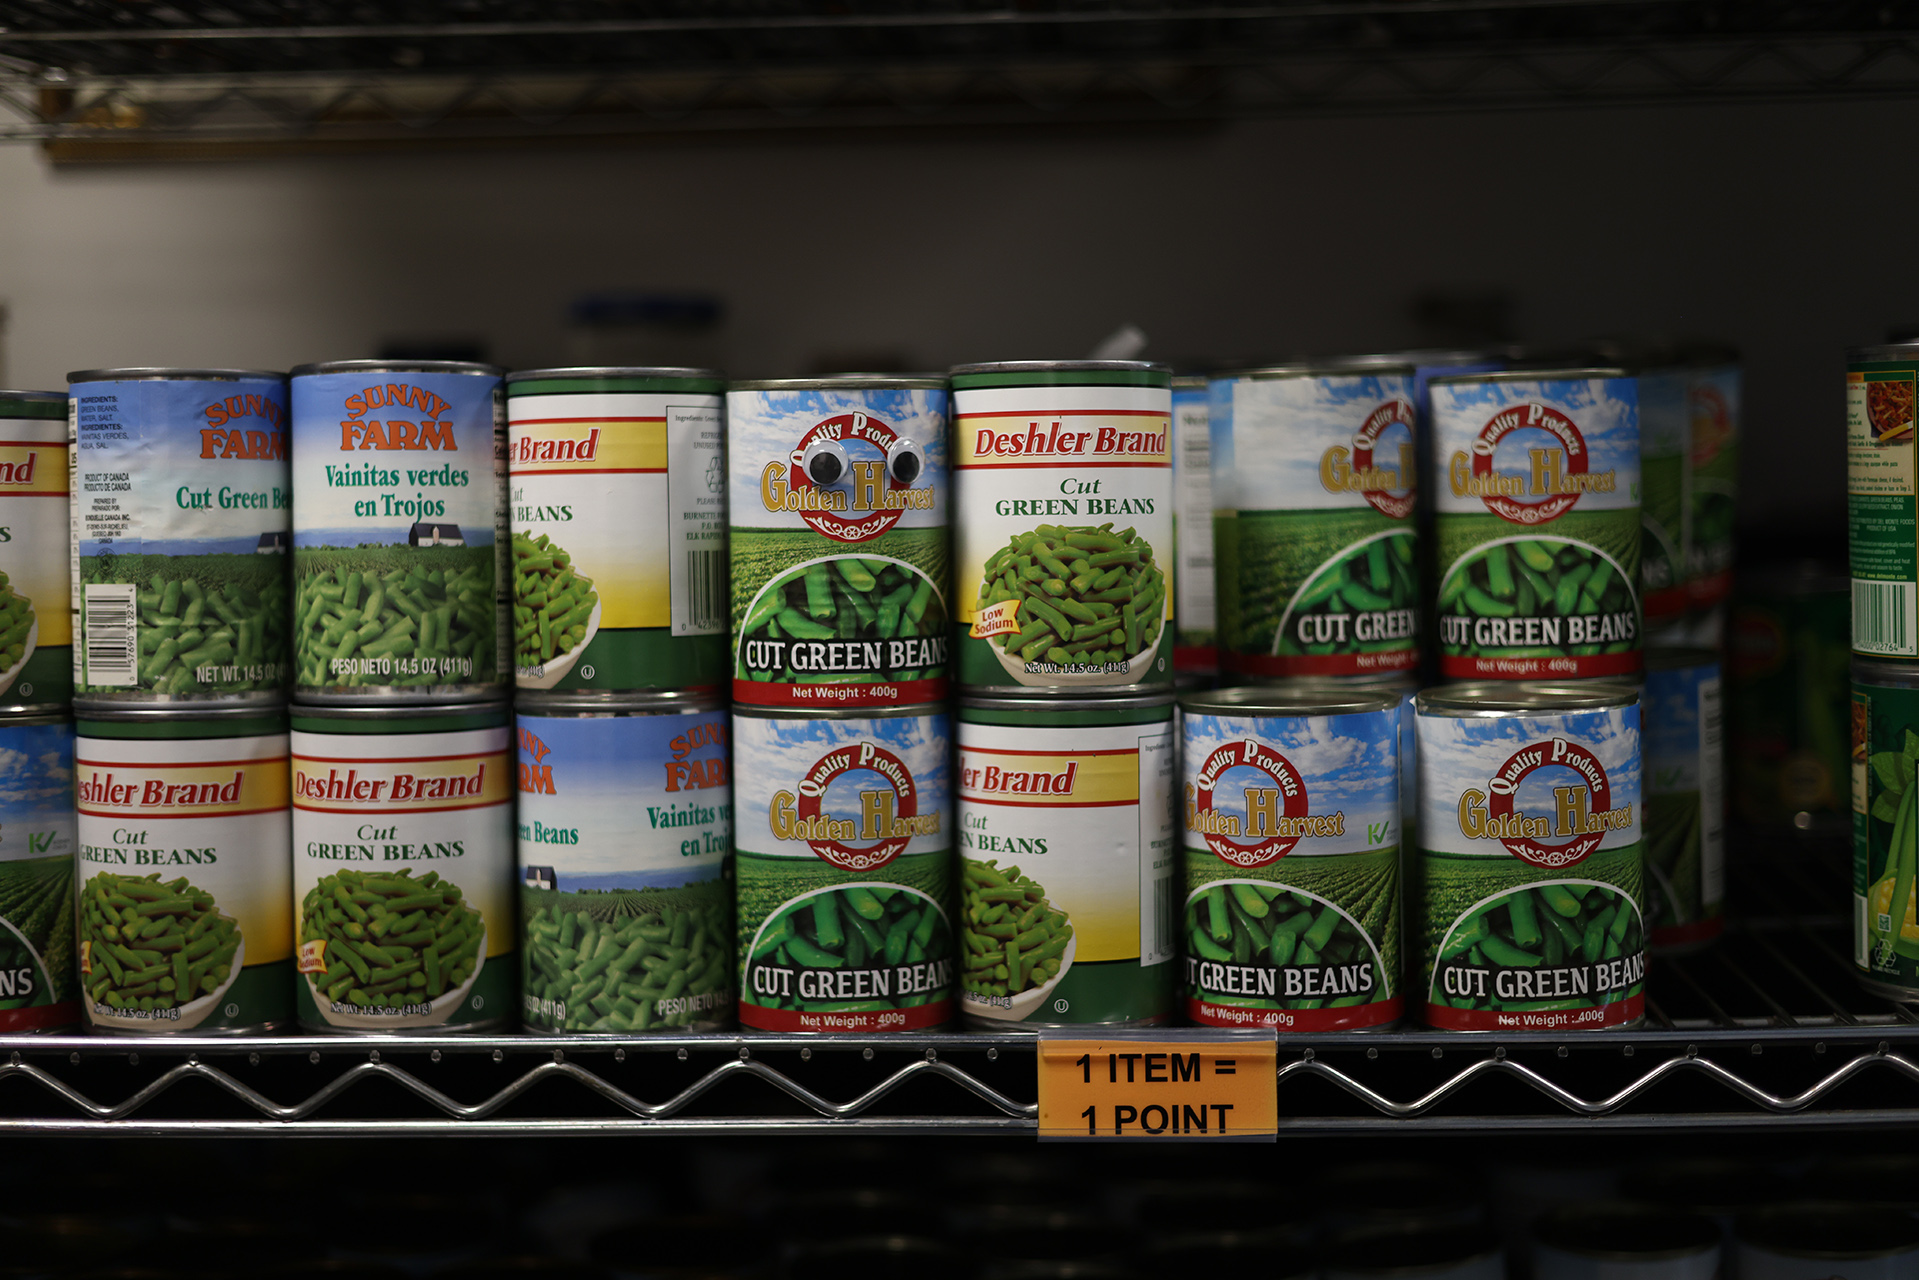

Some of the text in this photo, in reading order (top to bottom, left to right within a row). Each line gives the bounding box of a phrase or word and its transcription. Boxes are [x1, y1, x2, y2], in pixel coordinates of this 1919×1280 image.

[205, 393, 286, 430] SUNNY
[345, 384, 452, 420] SUNNY
[340, 420, 458, 451] FARM
[973, 421, 1167, 457] Deshler Brand
[1471, 403, 1581, 457] Quality Products
[199, 429, 288, 461] FARM
[519, 428, 600, 462] Brand
[325, 462, 469, 487] Vainitas verdes
[1319, 445, 1397, 495] Golden
[1449, 450, 1525, 499] Golden
[1528, 448, 1617, 496] Harvest
[176, 486, 268, 510] Cut Green
[760, 460, 935, 512] Golden Harvest
[1060, 477, 1102, 495] Cut
[354, 492, 445, 523] en Trojos
[518, 505, 573, 522] BEANS
[995, 498, 1154, 517] GREEN BEANS
[974, 617, 1013, 635] Sodium
[982, 607, 1004, 623] Low
[1297, 613, 1351, 644] CUT
[1439, 613, 1636, 646] CUT GREEN BEANS
[126, 604, 135, 664] 57690 31223
[332, 657, 473, 676] PESO NETO 14.5 OZ (411g)
[746, 636, 948, 670] CUT GREEN BEANS
[1356, 655, 1376, 668] Net
[1476, 659, 1578, 675] Net Weight 400g
[196, 665, 219, 683] NET
[221, 665, 241, 682] WT.
[243, 664, 263, 681] 14.5
[1024, 661, 1131, 675] Net Wt. 14.5 oz. (411g)
[792, 686, 898, 701] Net Weight 400g
[798, 741, 910, 798] Quality Products
[982, 760, 1079, 796] Brand
[1196, 749, 1236, 792] Quality
[1242, 738, 1298, 797] Products
[1489, 737, 1603, 796] Quality Products
[140, 770, 245, 807] Brand
[296, 762, 486, 802] Deshler Brand
[647, 802, 715, 829] Vainitas
[769, 789, 940, 840] Golden Harvest
[964, 812, 988, 831] Cut
[1184, 781, 1240, 837] Golden
[1244, 787, 1345, 838] Harvest
[1458, 785, 1632, 839] Golden Harvest
[113, 828, 148, 844] Cut
[357, 824, 398, 841] Cut
[534, 821, 579, 845] Beans
[978, 834, 1048, 855] BEANS
[81, 844, 217, 865] GREEN BEANS
[307, 841, 465, 861] GREEN BEANS
[681, 839, 701, 857] en
[753, 965, 890, 998] CUT GREEN
[1200, 961, 1373, 996] GREEN BEANS
[1444, 949, 1644, 998] CUT GREEN BEANS
[117, 1007, 181, 1021] 14.5 oz. (411g)
[331, 1002, 432, 1016] Net Wt. 14.5 oz. (411g)
[540, 998, 566, 1020] (411g)
[658, 996, 713, 1016] PESO NETO
[800, 1013, 906, 1028] Net Weight 400g
[1200, 1005, 1294, 1026] Net Weight 400g
[1498, 1009, 1604, 1028] Net Weight 400g
[1076, 1052, 1237, 1083] 1 ITEM =
[1081, 1104, 1234, 1135] 1 POINT
